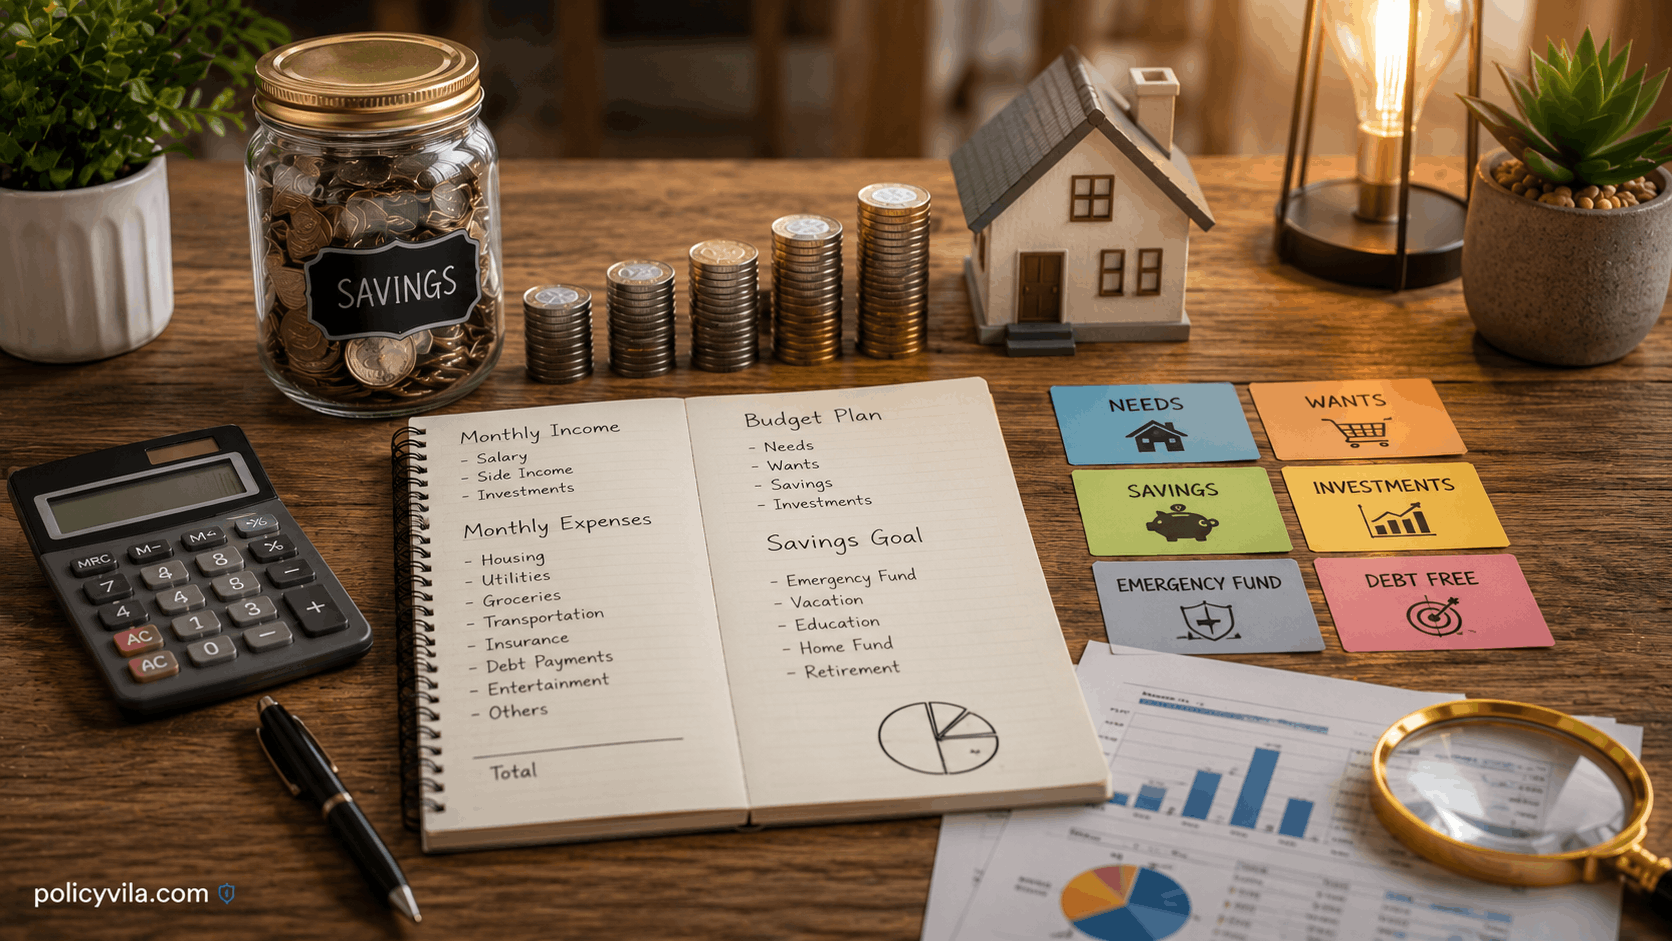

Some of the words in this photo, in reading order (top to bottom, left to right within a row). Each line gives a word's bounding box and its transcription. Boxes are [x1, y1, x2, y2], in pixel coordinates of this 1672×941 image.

[337, 265, 457, 309] SAVINGS
[1108, 396, 1184, 413] NEEDS
[1304, 393, 1387, 409] WANTS
[744, 410, 823, 432] Budget
[833, 407, 883, 423] Plan
[460, 425, 540, 445] Monthly
[549, 422, 621, 438] Income
[763, 439, 815, 453] Needs
[476, 451, 528, 465] Salary
[766, 458, 820, 472] Wants
[477, 468, 512, 483] Side
[518, 464, 574, 480] Income
[477, 483, 575, 501] Investments
[770, 478, 834, 493] Savings
[1127, 482, 1219, 499] SAVINGS
[1312, 477, 1456, 495] INVESTMENTS
[772, 495, 873, 511] Investments
[463, 517, 549, 539] Monthly
[560, 514, 652, 534] Expenses
[766, 533, 859, 556] Savings
[870, 526, 924, 547] Goal
[77, 554, 111, 569] MRC
[481, 552, 545, 567] Housing
[99, 579, 115, 593] 7
[482, 571, 551, 587] Utilities
[786, 573, 872, 590] Emergency
[877, 566, 918, 582] Fund
[1116, 576, 1226, 593] EMERGENCY
[1231, 575, 1282, 591] FUND
[1364, 572, 1418, 589] DEBT
[1426, 570, 1480, 587] FREE
[482, 591, 562, 608] Groceries
[789, 593, 864, 609] Vacation
[115, 604, 131, 618] 4
[244, 602, 261, 616] 3
[189, 616, 204, 630] 1
[482, 608, 605, 629] Transportation
[794, 615, 881, 632] Education
[127, 630, 153, 646] AC
[484, 634, 570, 652] Insurance
[799, 640, 846, 655] Home
[852, 634, 894, 652] Fund
[142, 655, 168, 672] AC
[485, 657, 526, 674] Debt
[534, 650, 614, 672] Payments
[804, 659, 901, 679] Retirement
[487, 672, 610, 697] Entertainment
[488, 703, 549, 721] Others
[489, 761, 538, 781] Total
